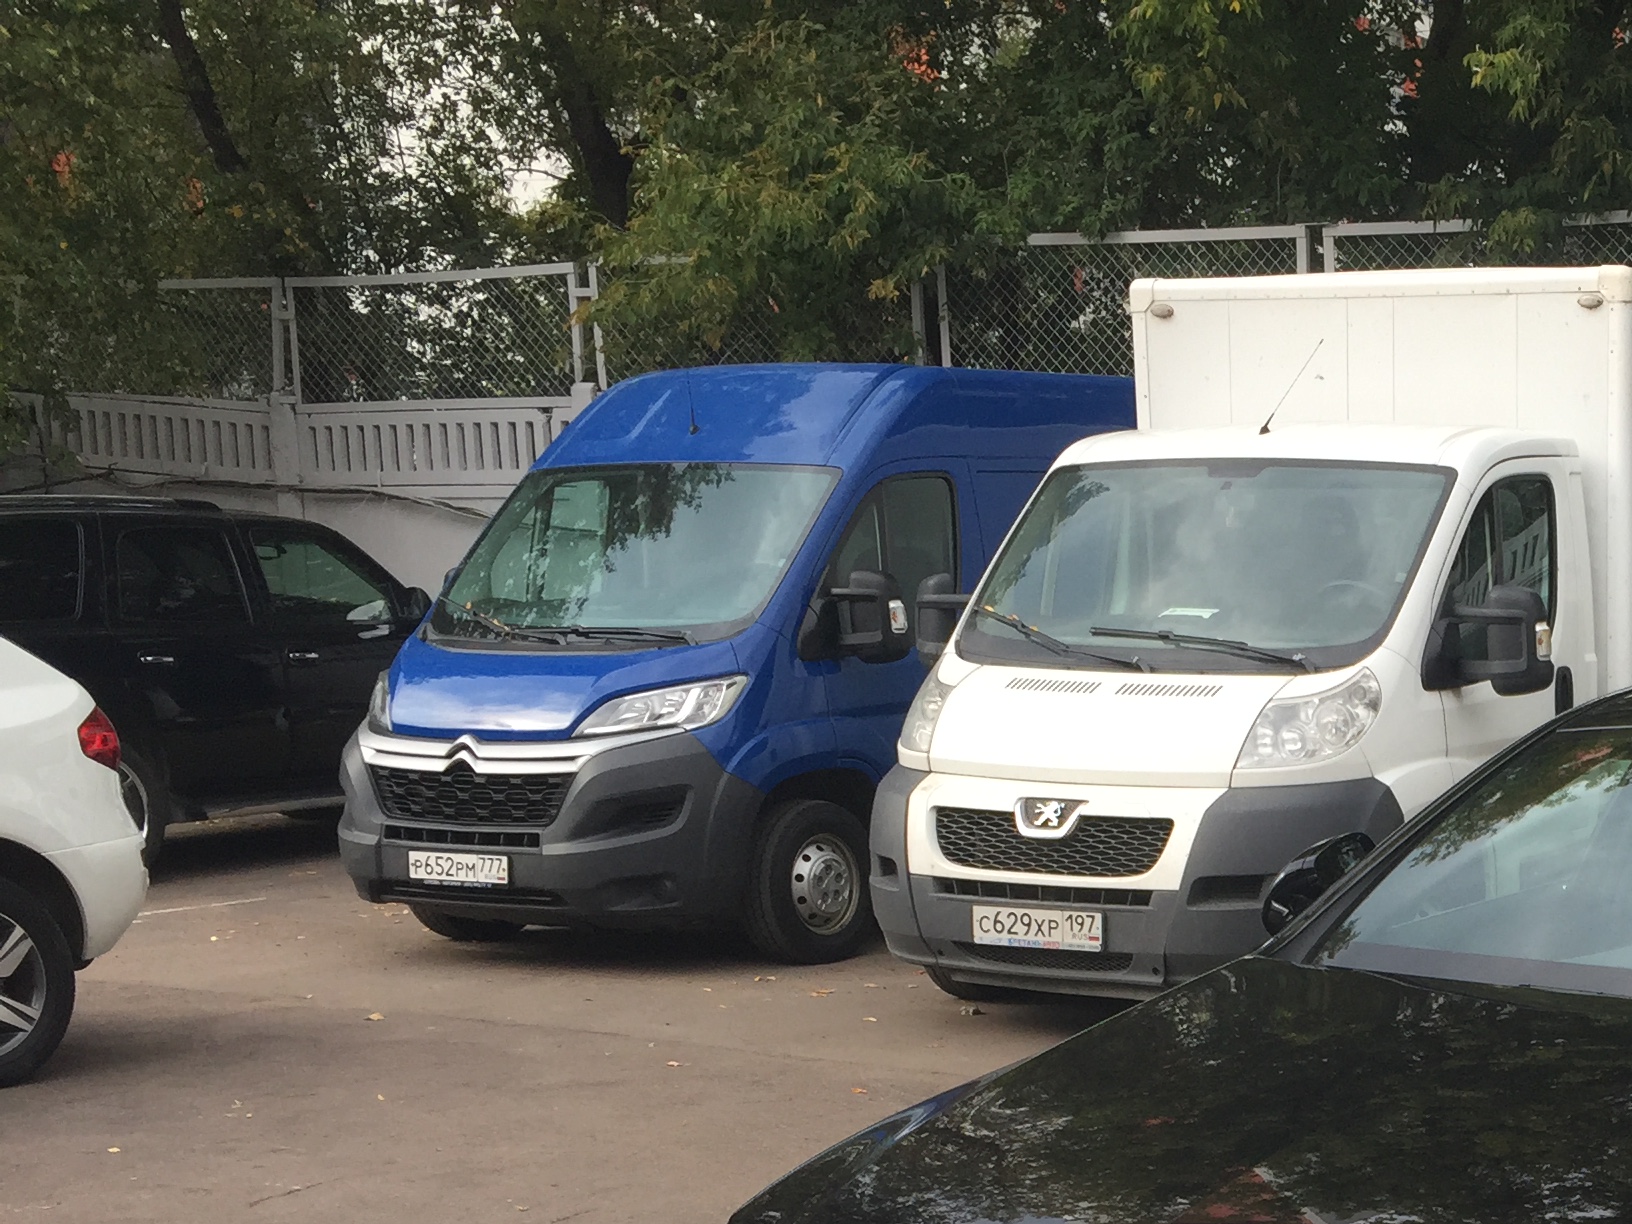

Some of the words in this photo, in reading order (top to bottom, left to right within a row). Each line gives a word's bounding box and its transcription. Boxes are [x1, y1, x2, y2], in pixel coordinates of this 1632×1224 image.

[414, 855, 476, 878] Р652РМ
[478, 857, 503, 874] 777
[979, 911, 1059, 938] С629ХР
[1065, 914, 1096, 933] 197
[1072, 932, 1088, 941] RUS
